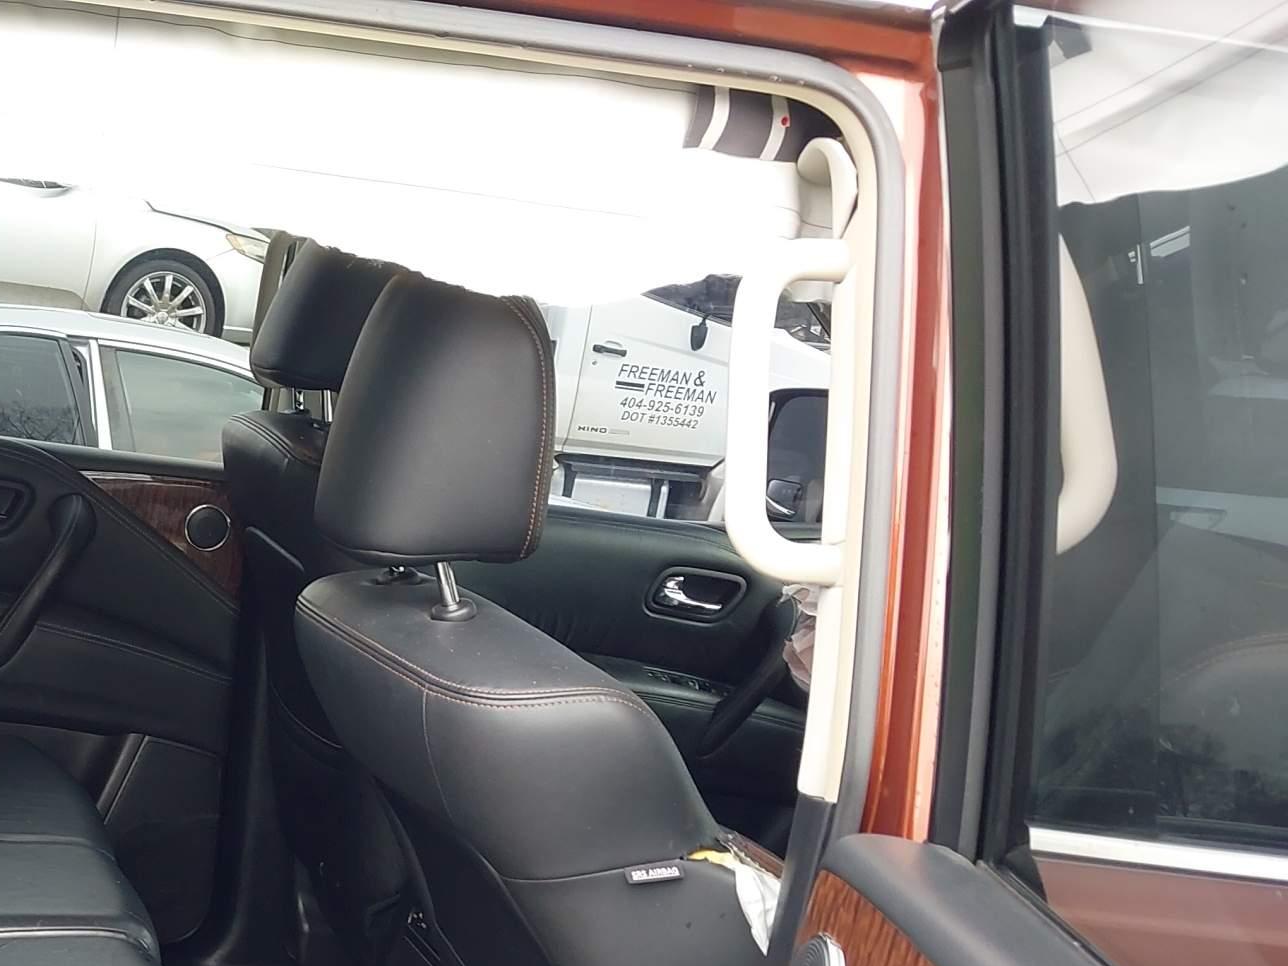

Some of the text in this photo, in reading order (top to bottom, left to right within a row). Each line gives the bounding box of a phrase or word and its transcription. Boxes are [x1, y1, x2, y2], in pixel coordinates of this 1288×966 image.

[618, 363, 707, 387] FREEMAN &
[644, 382, 717, 405] FREEMAN
[619, 396, 705, 418] 404-925-6139
[577, 425, 608, 434] HINO
[620, 410, 699, 430] DOT #1355442
[649, 866, 680, 878] AIRBAG
